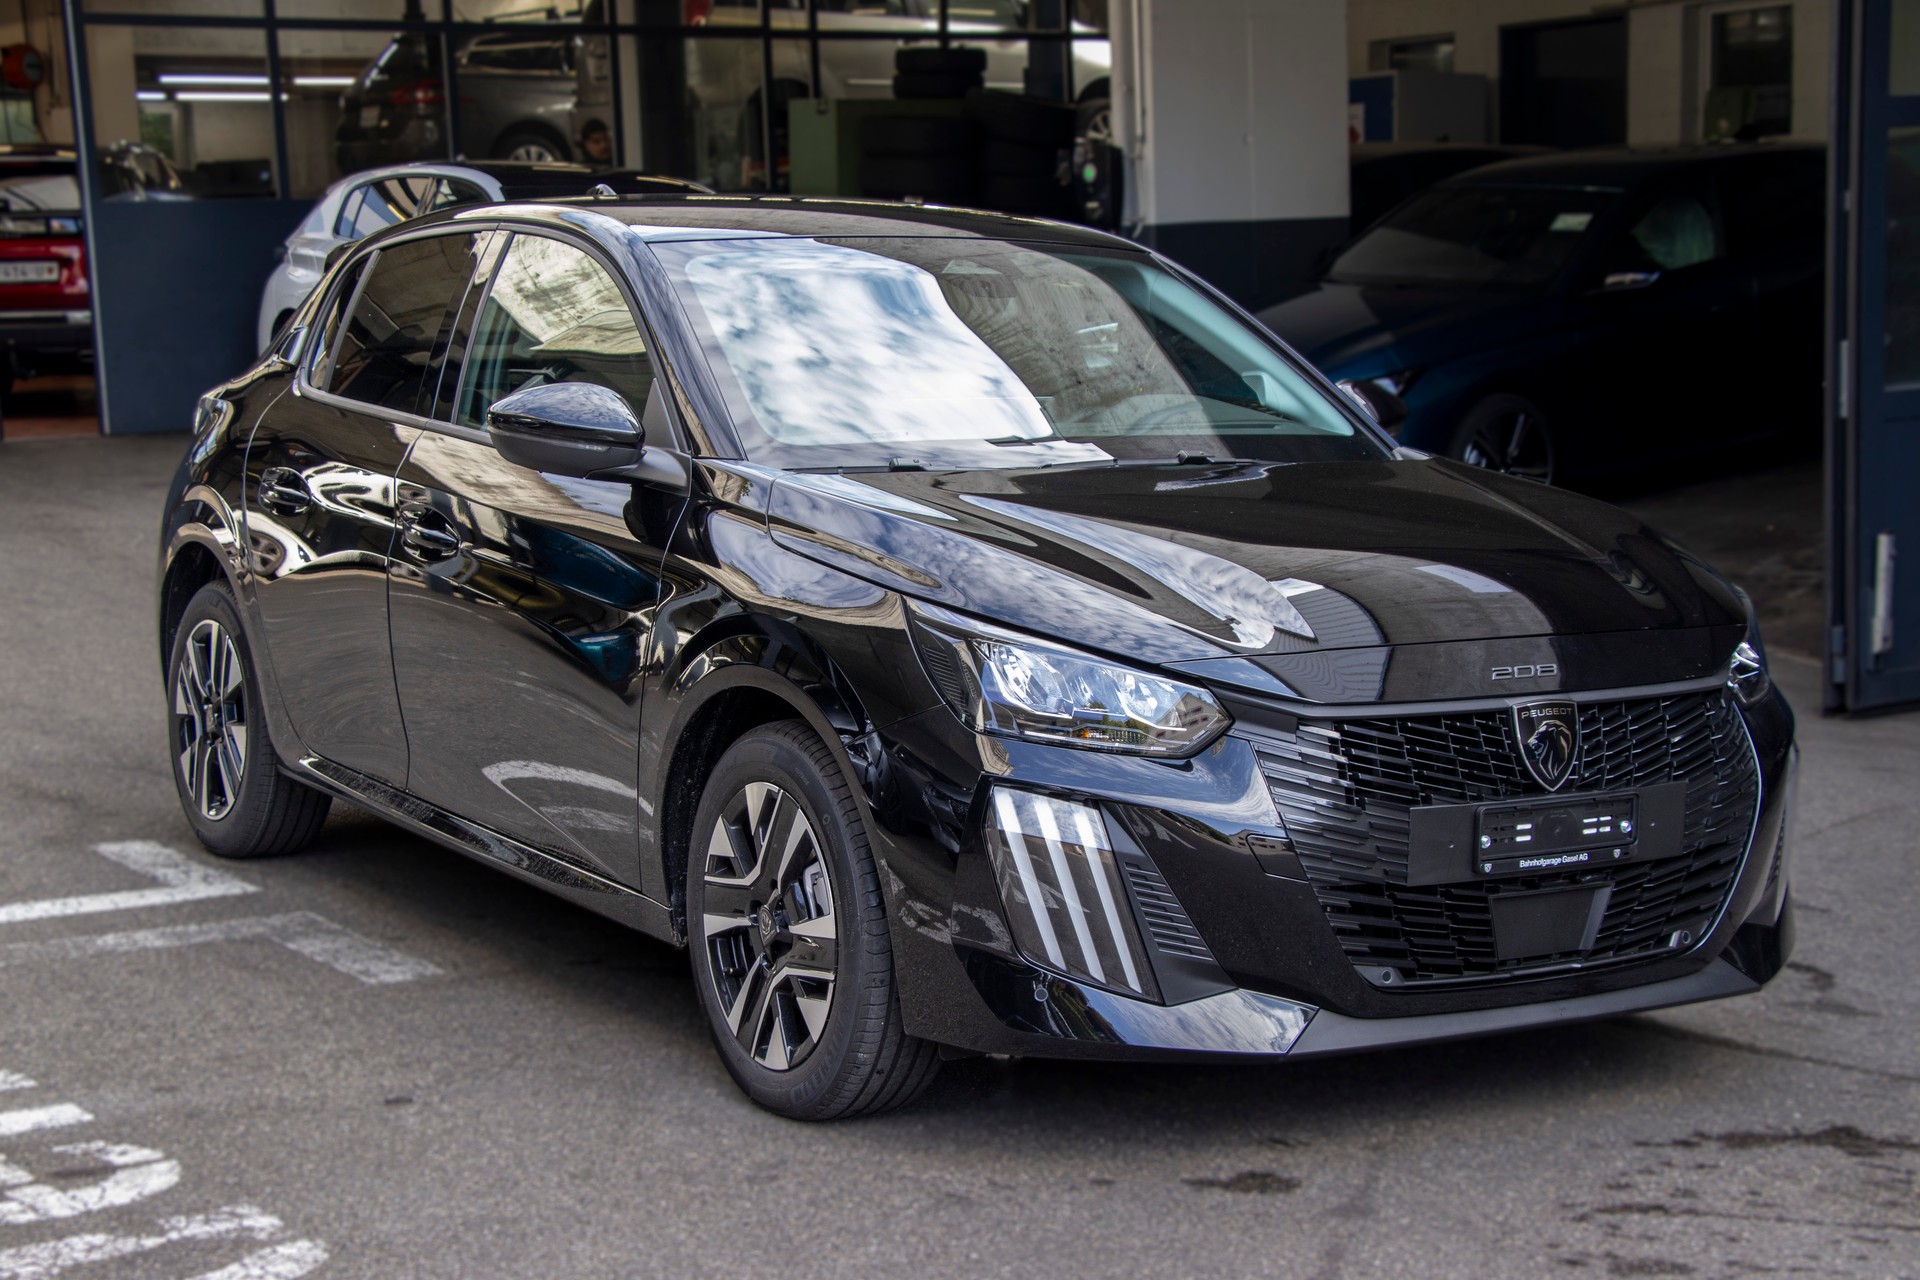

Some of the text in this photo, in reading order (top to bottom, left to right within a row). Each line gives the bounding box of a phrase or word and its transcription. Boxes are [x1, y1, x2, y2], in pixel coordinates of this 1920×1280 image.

[1491, 663, 1558, 680] 208
[1521, 707, 1573, 719] PEUGEOT
[1519, 857, 1562, 868] Bahnhofgarage
[1579, 852, 1589, 861] AG
